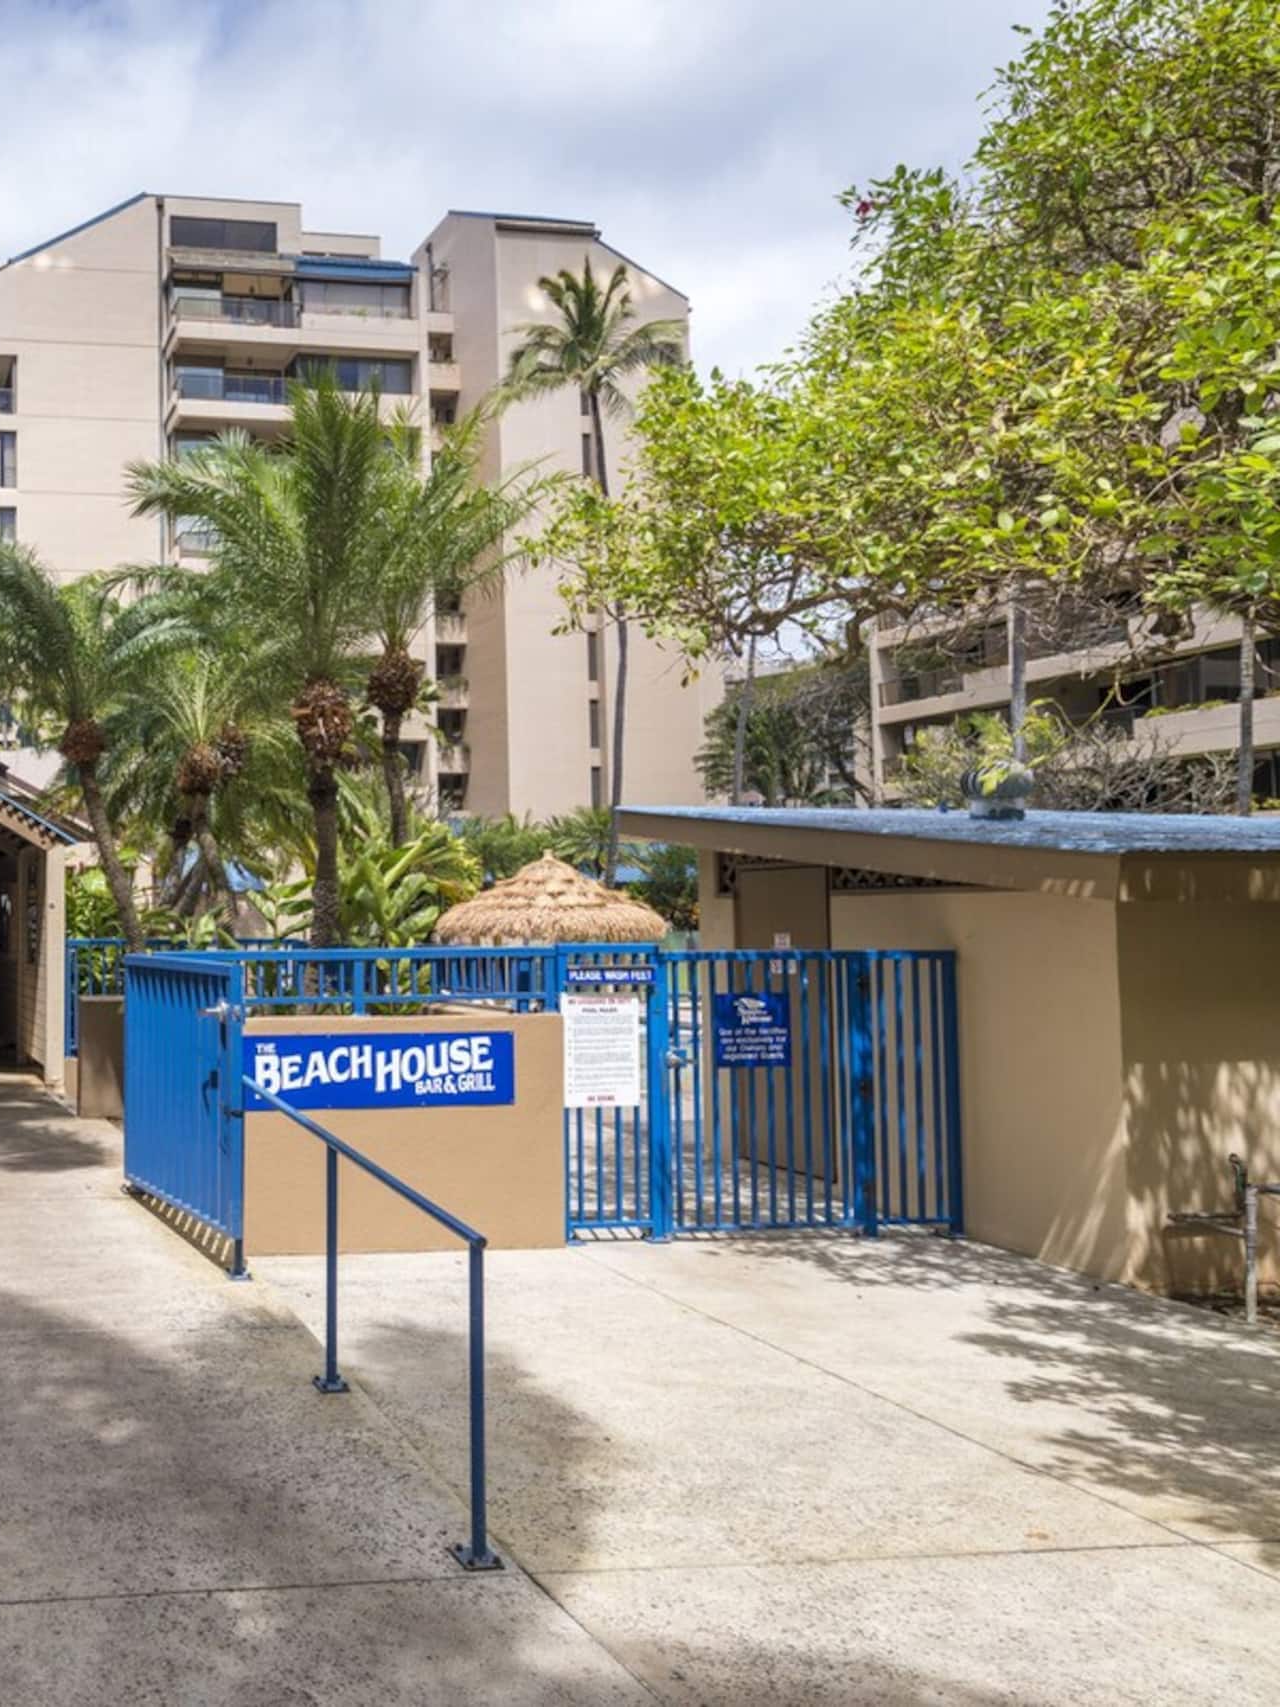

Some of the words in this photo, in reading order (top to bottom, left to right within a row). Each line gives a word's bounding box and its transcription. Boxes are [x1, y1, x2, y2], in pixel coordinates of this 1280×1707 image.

[568, 969, 603, 981] PLEASE
[255, 1043, 277, 1055] THE
[254, 1044, 373, 1099] BEACH
[375, 1036, 494, 1092] HOUSE
[415, 1078, 443, 1095] BAR
[458, 1072, 496, 1091] GRILL
